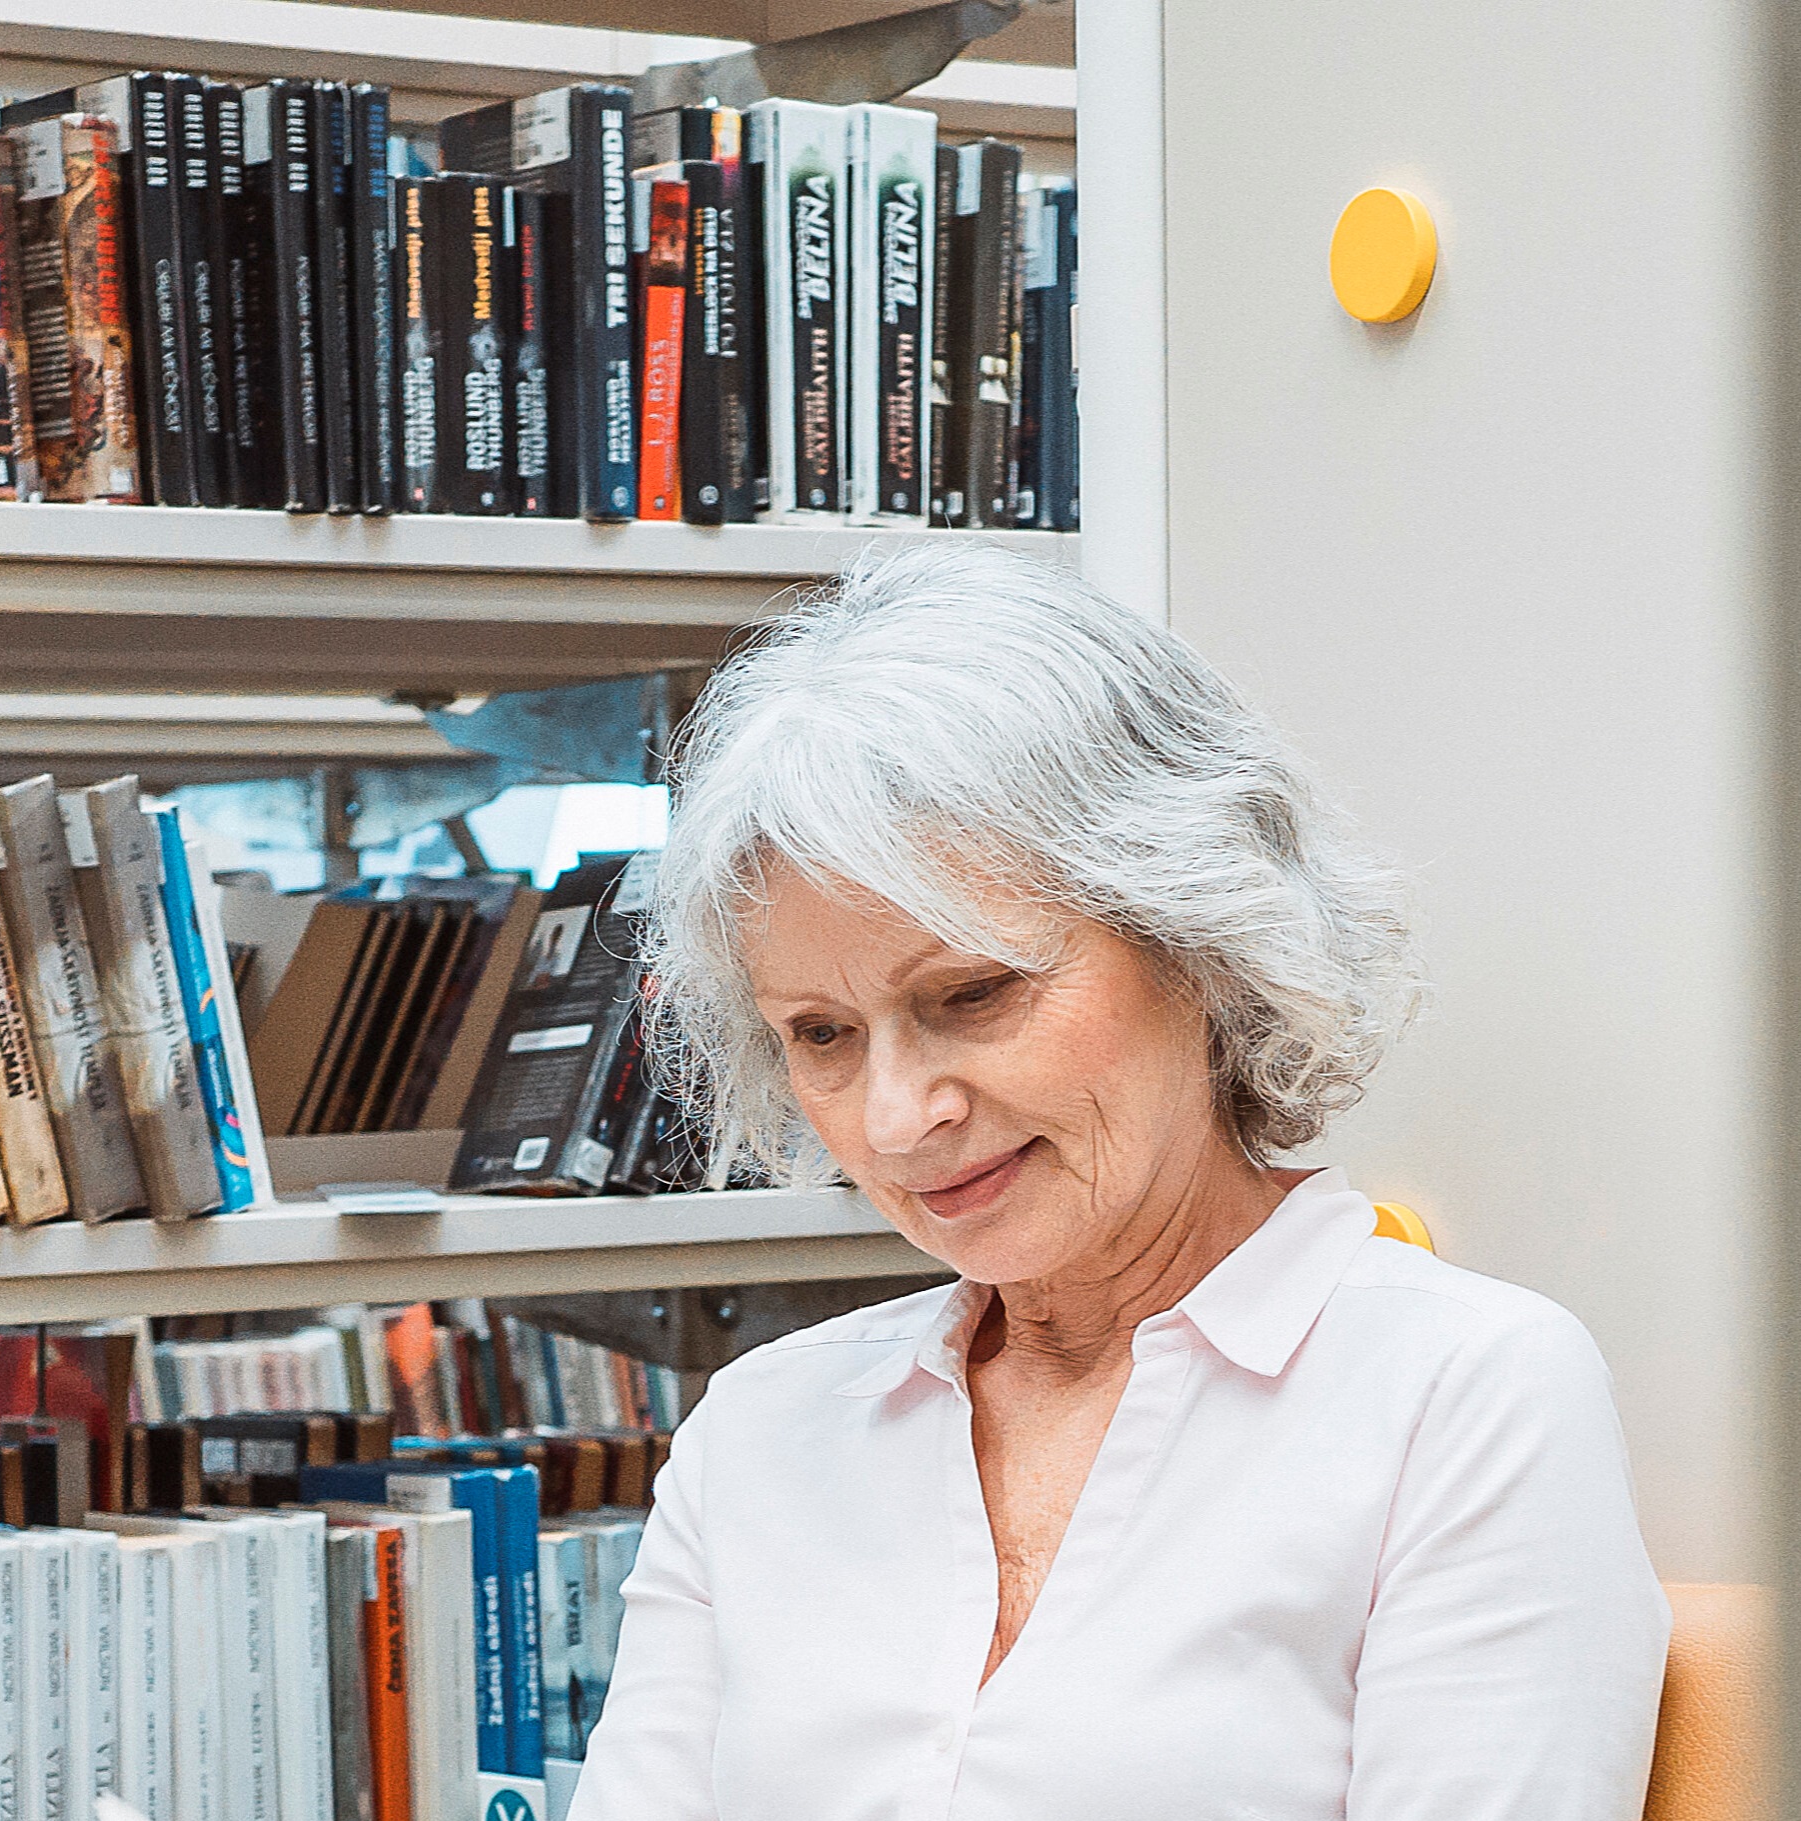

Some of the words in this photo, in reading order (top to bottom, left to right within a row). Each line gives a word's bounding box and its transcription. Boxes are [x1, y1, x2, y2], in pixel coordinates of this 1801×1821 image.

[472, 186, 493, 228] ples
[601, 109, 627, 267] SEKUNDE
[804, 175, 832, 301] BELINA
[895, 181, 918, 307] BELINA
[472, 232, 494, 321] Medvedji
[605, 272, 628, 329] TRI
[464, 371, 487, 472] ROSLUND
[811, 326, 830, 477] GALBRAITH
[898, 332, 916, 481] GALBRAITH
